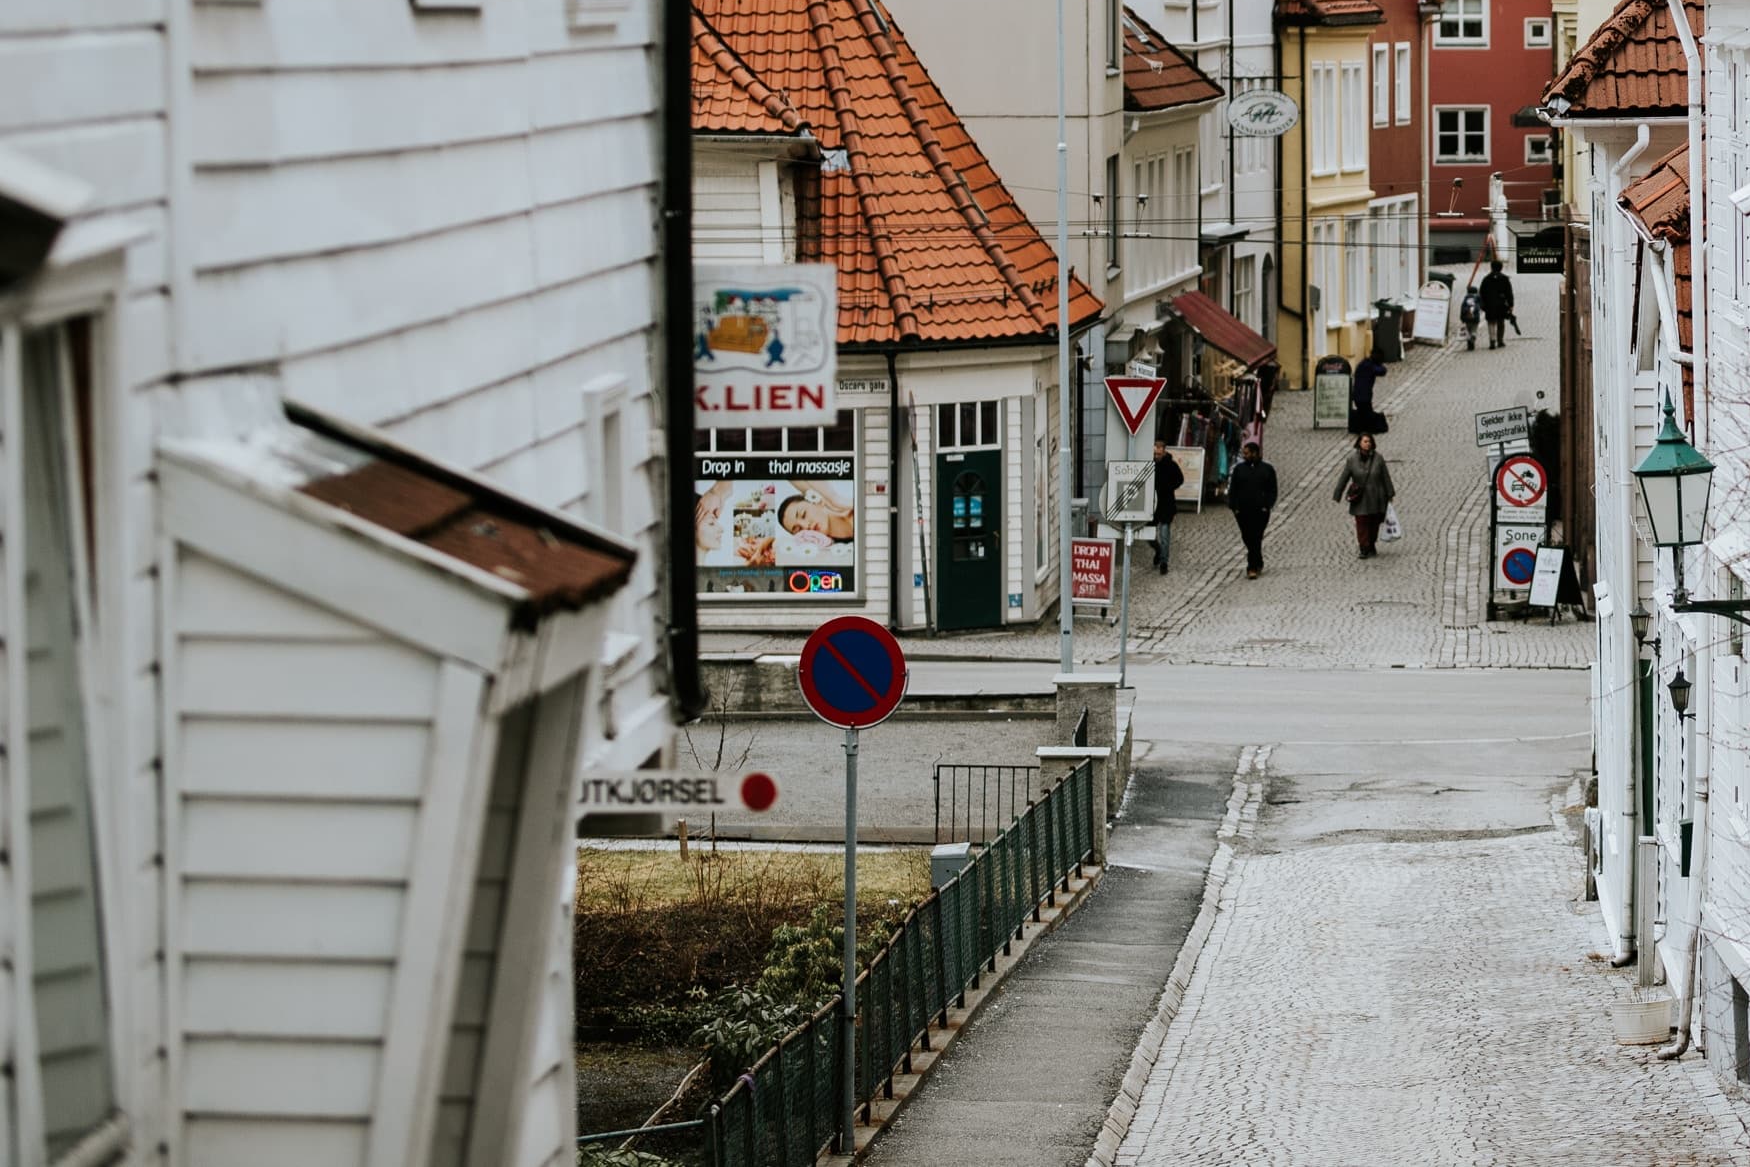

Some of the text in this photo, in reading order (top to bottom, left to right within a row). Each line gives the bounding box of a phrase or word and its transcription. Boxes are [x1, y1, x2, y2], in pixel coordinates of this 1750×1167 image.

[839, 380, 885, 393] Oscars gate
[1481, 411, 1523, 426] Gjelder ikke
[1479, 424, 1527, 440] anleggstrafikk
[702, 459, 731, 477] Drop
[768, 459, 793, 474] thai
[796, 460, 850, 477] massasje
[1505, 529, 1537, 541] Sone
[1073, 545, 1110, 557] DROP IN
[1074, 558, 1100, 570] THAI
[789, 570, 842, 593] Open
[1072, 572, 1106, 584] MASSA
